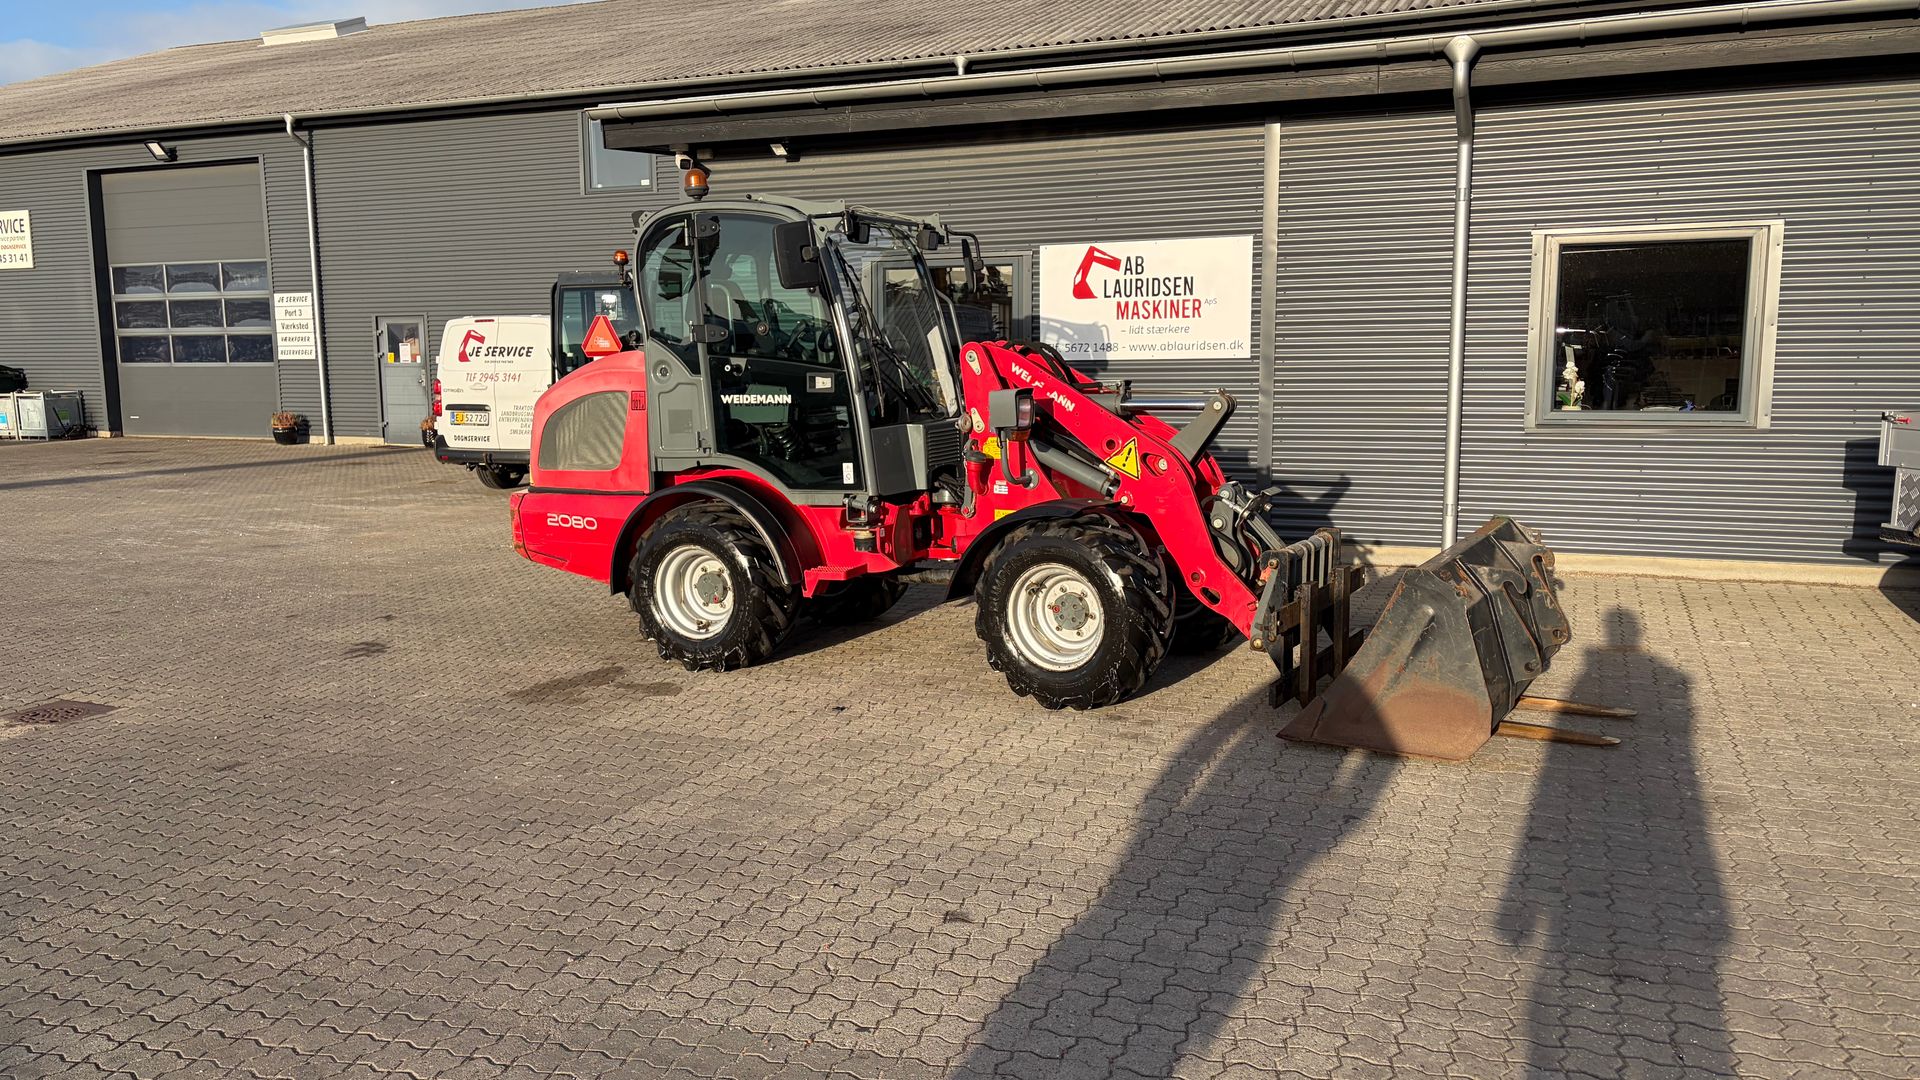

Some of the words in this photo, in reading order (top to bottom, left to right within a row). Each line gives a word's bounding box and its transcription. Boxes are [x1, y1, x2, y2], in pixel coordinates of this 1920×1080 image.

[9, 254, 17, 263] 31
[19, 253, 28, 262] 41
[1123, 256, 1145, 276] AB
[1103, 276, 1194, 299] LAURIDSEN
[286, 295, 308, 303] SERVICE
[284, 309, 297, 317] Port
[298, 309, 303, 317] 3
[1116, 298, 1202, 320] MASKINER
[1204, 298, 1218, 306] ApS
[280, 322, 309, 330] Værksted
[1128, 325, 1144, 335] lidt
[1146, 325, 1190, 335] stærkere
[1065, 342, 1090, 353] 5672
[1093, 341, 1119, 352] 1488
[1128, 340, 1244, 352] www.ablauridsen.dk
[468, 346, 482, 357] JE
[484, 346, 534, 358] SERVICE
[465, 372, 478, 382] TLF
[479, 372, 500, 382] 2945
[502, 372, 521, 383] 3141
[720, 394, 792, 404] WEIDEMANN
[456, 413, 464, 422] EJ
[547, 513, 597, 530] 2080
